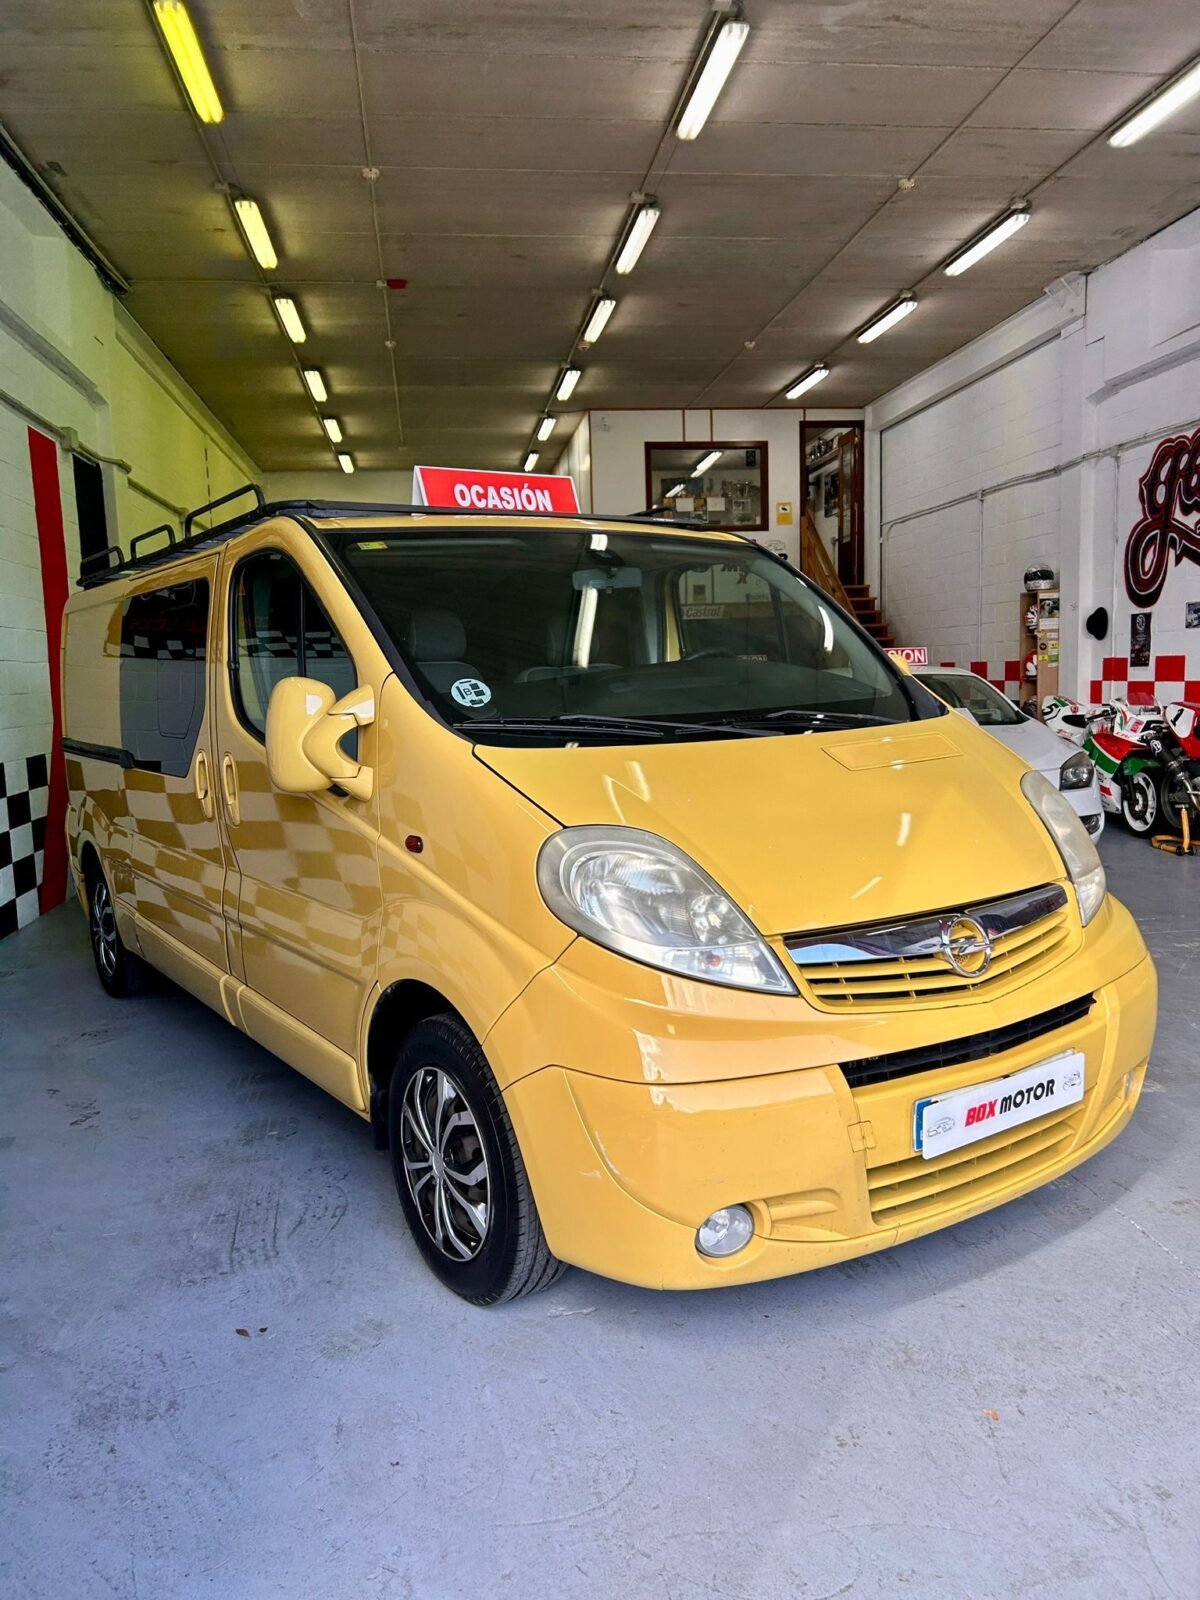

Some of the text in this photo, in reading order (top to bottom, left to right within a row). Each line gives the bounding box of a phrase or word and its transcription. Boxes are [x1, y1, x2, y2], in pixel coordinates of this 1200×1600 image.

[453, 483, 553, 511] OCASIÓN
[686, 606, 722, 618] Castrol
[462, 687, 473, 696] B
[1041, 702, 1059, 716] 5
[1170, 707, 1185, 728] 1
[965, 1078, 1055, 1127] BOX MOTOR
